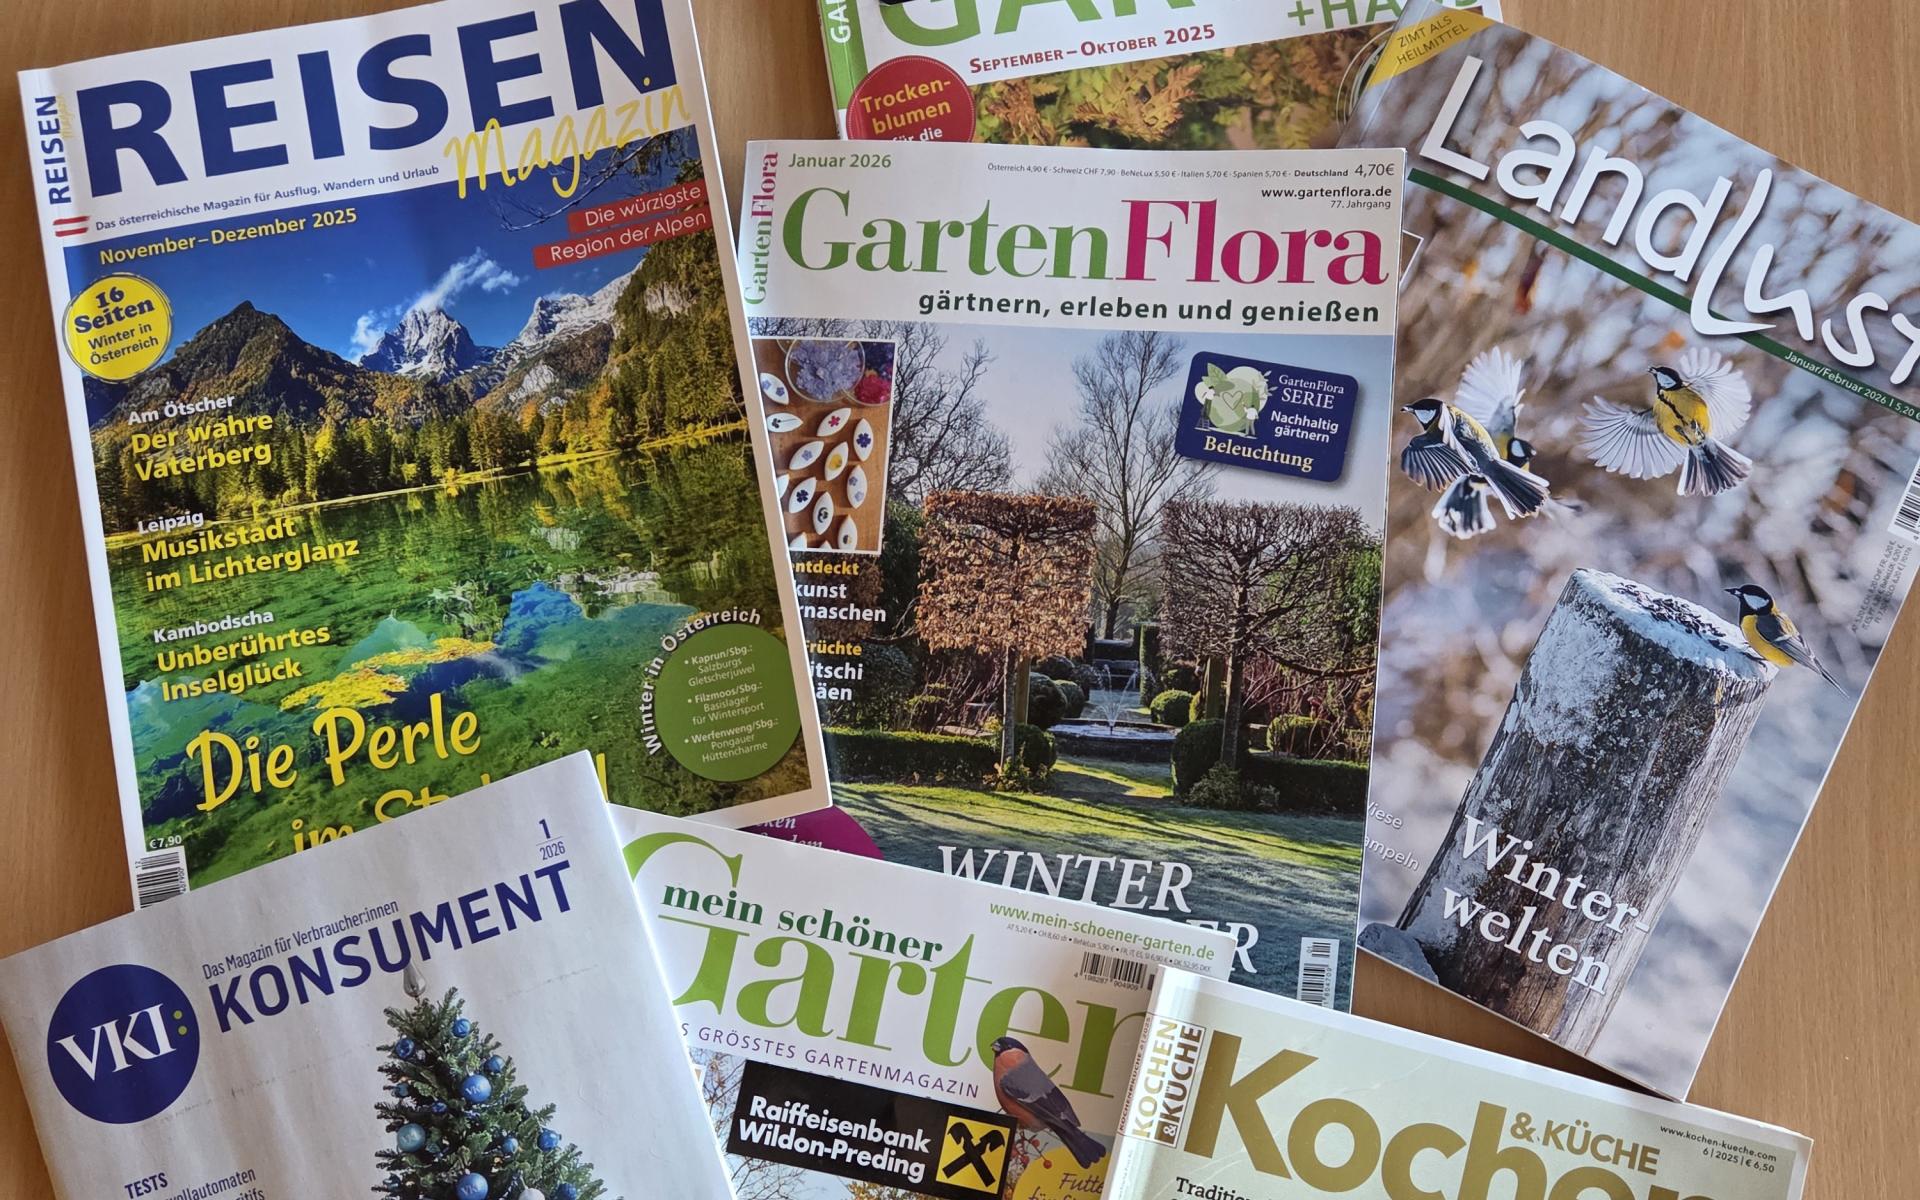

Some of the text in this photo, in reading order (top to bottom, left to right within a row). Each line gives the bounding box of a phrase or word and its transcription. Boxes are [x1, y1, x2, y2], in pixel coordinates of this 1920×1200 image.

[1164, 24, 1217, 46] 2025
[1396, 24, 1468, 65] HEILMITTEL
[1397, 15, 1452, 48] ZIMT ALS
[76, 0, 677, 198] REISEN
[860, 79, 952, 114] Trocken-
[872, 100, 952, 135] blumen
[920, 126, 944, 141] die
[35, 95, 71, 205] REISEN
[443, 77, 691, 199] Magazin
[788, 153, 893, 168] Januar 2026
[987, 163, 1026, 173] Österreich
[1026, 165, 1042, 173] 4,90
[1053, 166, 1083, 174] Schweiz
[1084, 167, 1100, 175] CHF
[1100, 168, 1116, 176] 7,90
[1154, 170, 1170, 178] 5,50
[1180, 170, 1204, 178] Italien
[1206, 170, 1222, 179] 5,70
[1233, 170, 1263, 179] Spanien
[1265, 170, 1281, 178] 5,70
[1294, 169, 1348, 177] Deutschland
[1354, 163, 1395, 178] 4,70€
[95, 165, 440, 231] Das österreichische Magazin für Ausflug, Wandern und Urlaub
[585, 186, 701, 227] Die würzigste
[1261, 186, 1392, 200] www.gartenflora.de
[1331, 199, 1391, 210] 77. Jahrgang
[312, 208, 358, 229] 2025
[743, 152, 778, 305] GartenFlora
[782, 187, 1389, 285] GartenFlora
[551, 213, 707, 262] Region der Alpen
[96, 286, 124, 308] 16
[919, 289, 1380, 326] gärtnern, erleben und genießen
[74, 299, 155, 333] Seiten
[88, 323, 152, 350] Winter in
[91, 336, 159, 365] Österreich
[1279, 374, 1345, 395] GartenFlora
[1281, 388, 1335, 410] SERIE
[1785, 351, 1863, 393] Januar/Februar
[1864, 388, 1887, 405] 2026
[1895, 402, 1915, 417] 5,20
[128, 395, 235, 426] Am Ötscher
[1270, 411, 1339, 434] Nachhaltig
[131, 414, 273, 454] Der wahre
[1274, 425, 1330, 443] gärtnern
[134, 442, 273, 483] Vaterberg
[1203, 435, 1314, 473] Beleuchtung
[138, 511, 204, 535] Leipzig
[142, 517, 296, 563] Musikstadt
[146, 538, 360, 592] im Lichterglanz
[792, 560, 860, 576] ntdeckt
[154, 609, 274, 644] Kambodscha
[157, 625, 331, 672] Unberührtes
[691, 645, 753, 665] Kaprun/Sbg.:
[698, 657, 742, 674] Salzburgs
[162, 658, 302, 702] Inselglück
[638, 606, 761, 755] Winter in Österreich
[688, 664, 755, 687] Gletscherjuwel
[694, 682, 763, 703] Filzmoos/Sbg.:
[692, 702, 765, 726] für Wintersport
[704, 695, 750, 713] Basislager
[692, 718, 779, 744] Werfenweng/Sbg.:
[711, 733, 755, 750] Pongauer
[186, 729, 298, 812] Die
[313, 693, 481, 787] Perle
[702, 741, 768, 763] Hüttencharme
[538, 818, 551, 839] 1
[539, 840, 566, 860] 2026
[938, 846, 1193, 913] WINTER
[1461, 814, 1650, 935] Winter-
[203, 900, 400, 980] Das Magazin für Verbraucher:innen
[661, 884, 943, 962] mein schöner
[990, 902, 1215, 961] www.mein-schoener-garten.de
[208, 860, 572, 1033] KONSUMENT
[1441, 887, 1611, 995] welten
[698, 1025, 796, 1059] GRÖSSTES
[805, 1049, 979, 1098] GARTENMAGAZIN
[1132, 1020, 1178, 1139] KOCHEN
[749, 1095, 932, 1154] Raiffeisenbank
[739, 1119, 926, 1184] Wildon-Preding
[1509, 1112, 1661, 1175] & KÜCHE
[1660, 1125, 1777, 1162] www.kochen-kueche.com
[124, 1172, 169, 1200] TESTS
